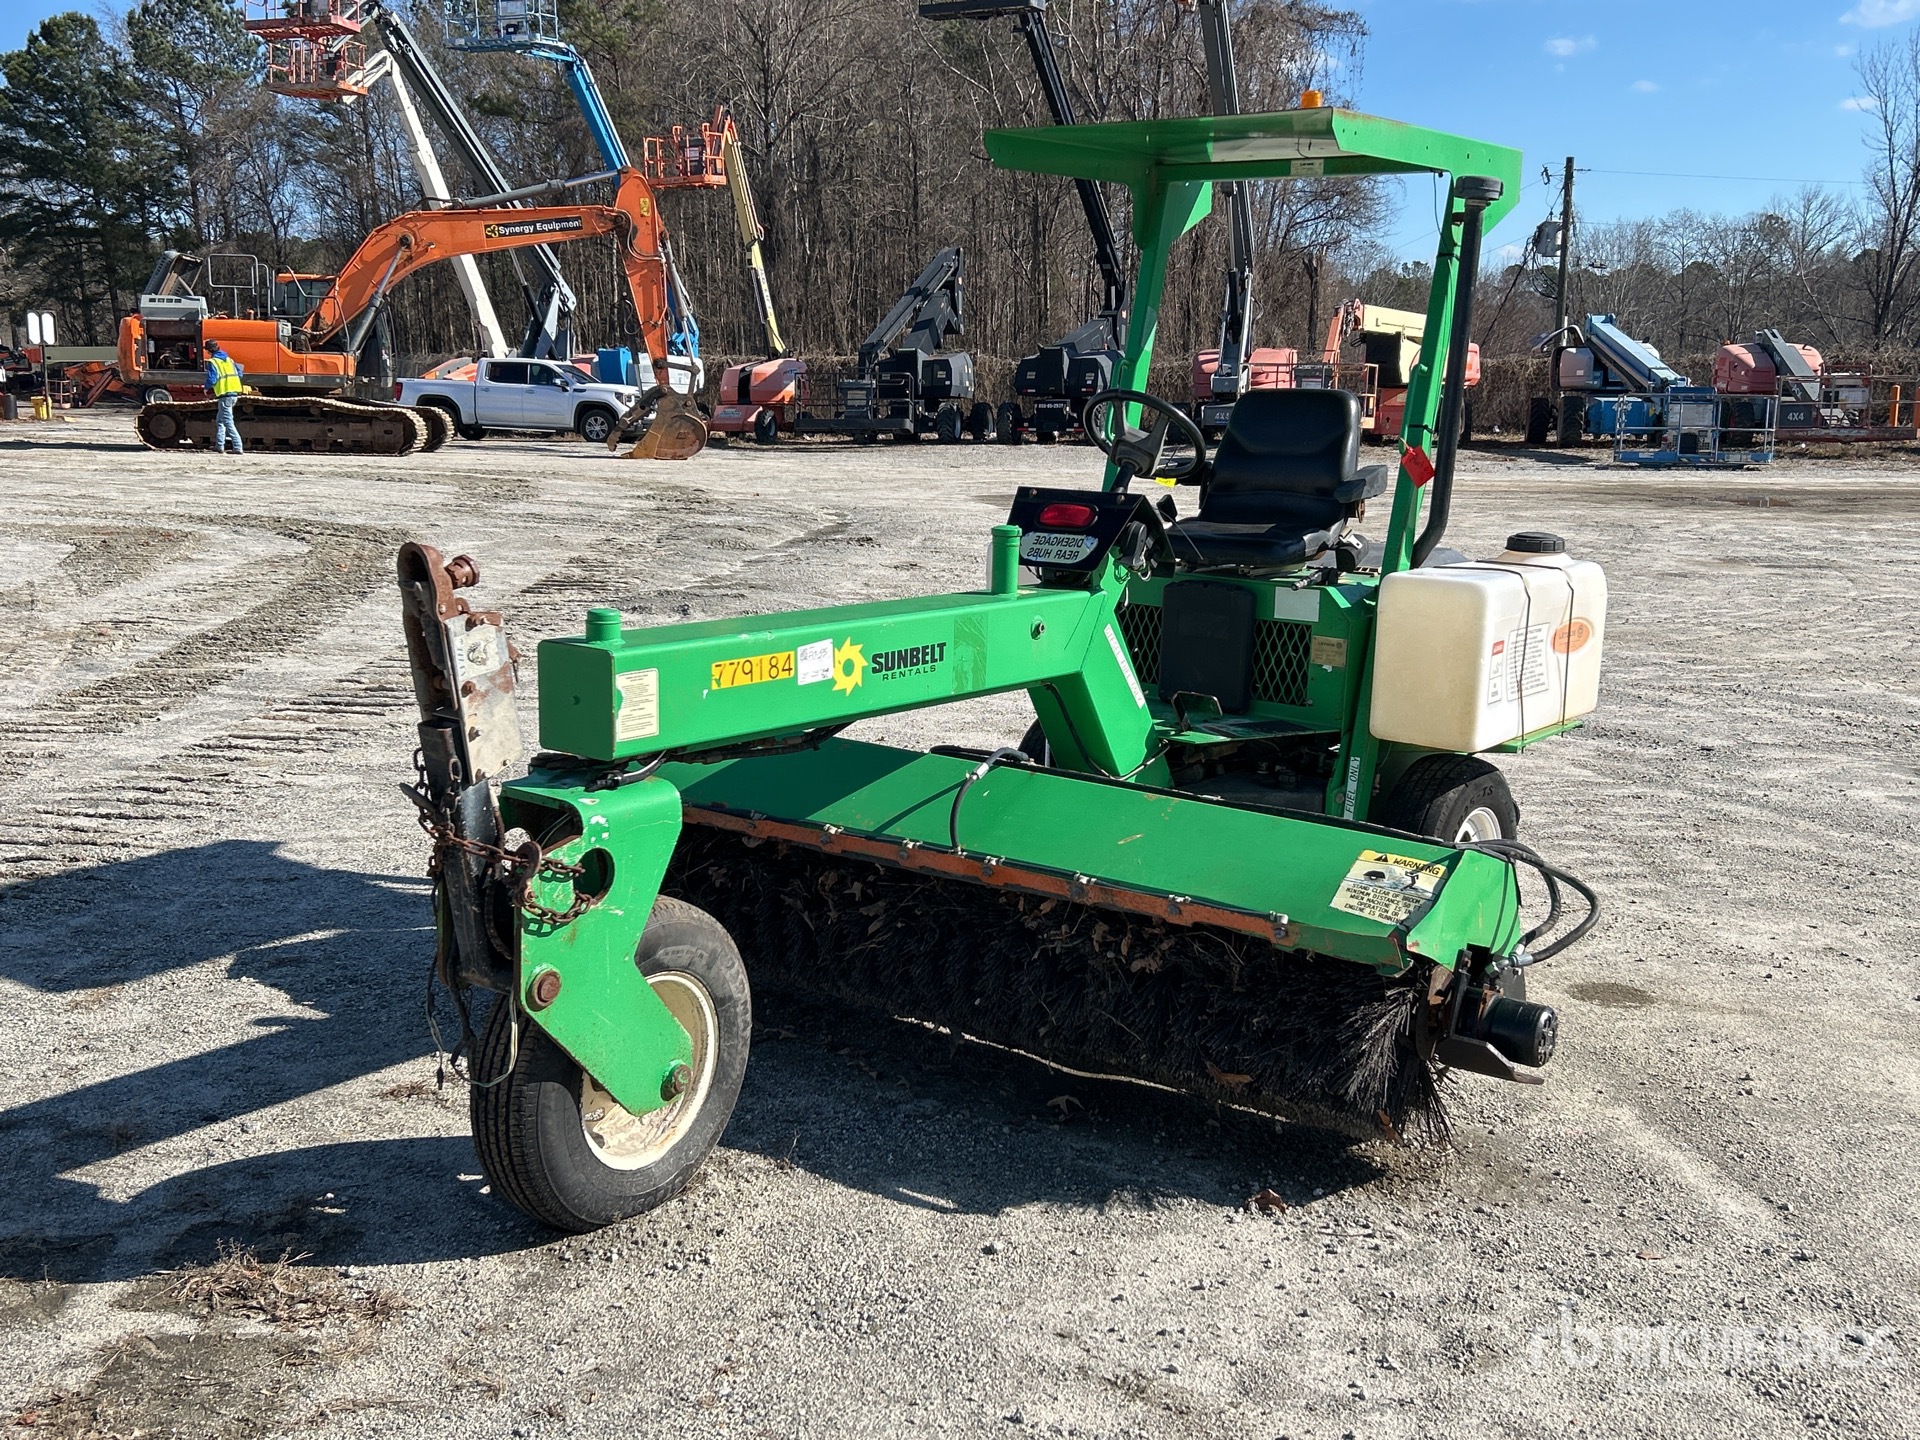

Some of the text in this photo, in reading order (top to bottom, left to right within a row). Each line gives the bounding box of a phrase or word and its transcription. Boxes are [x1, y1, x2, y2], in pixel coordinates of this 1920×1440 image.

[499, 219, 583, 235] Synergy Equipment
[1787, 412, 1804, 421] 4X4
[871, 642, 947, 675] SUNBELT
[714, 652, 794, 686] 779184
[882, 664, 937, 681] RENTALS
[1345, 757, 1361, 814] FUEL ONLY
[1393, 858, 1441, 876] WARNING
[1345, 887, 1371, 897] MINIMUM
[1372, 893, 1401, 906] DISTANCE
[1371, 887, 1390, 897] CLEAR
[1356, 901, 1399, 918] OPERATION OR
[1366, 897, 1392, 908] MACHINE
[1344, 903, 1366, 913] ENGINE
[1378, 913, 1404, 924] RUNNIN
